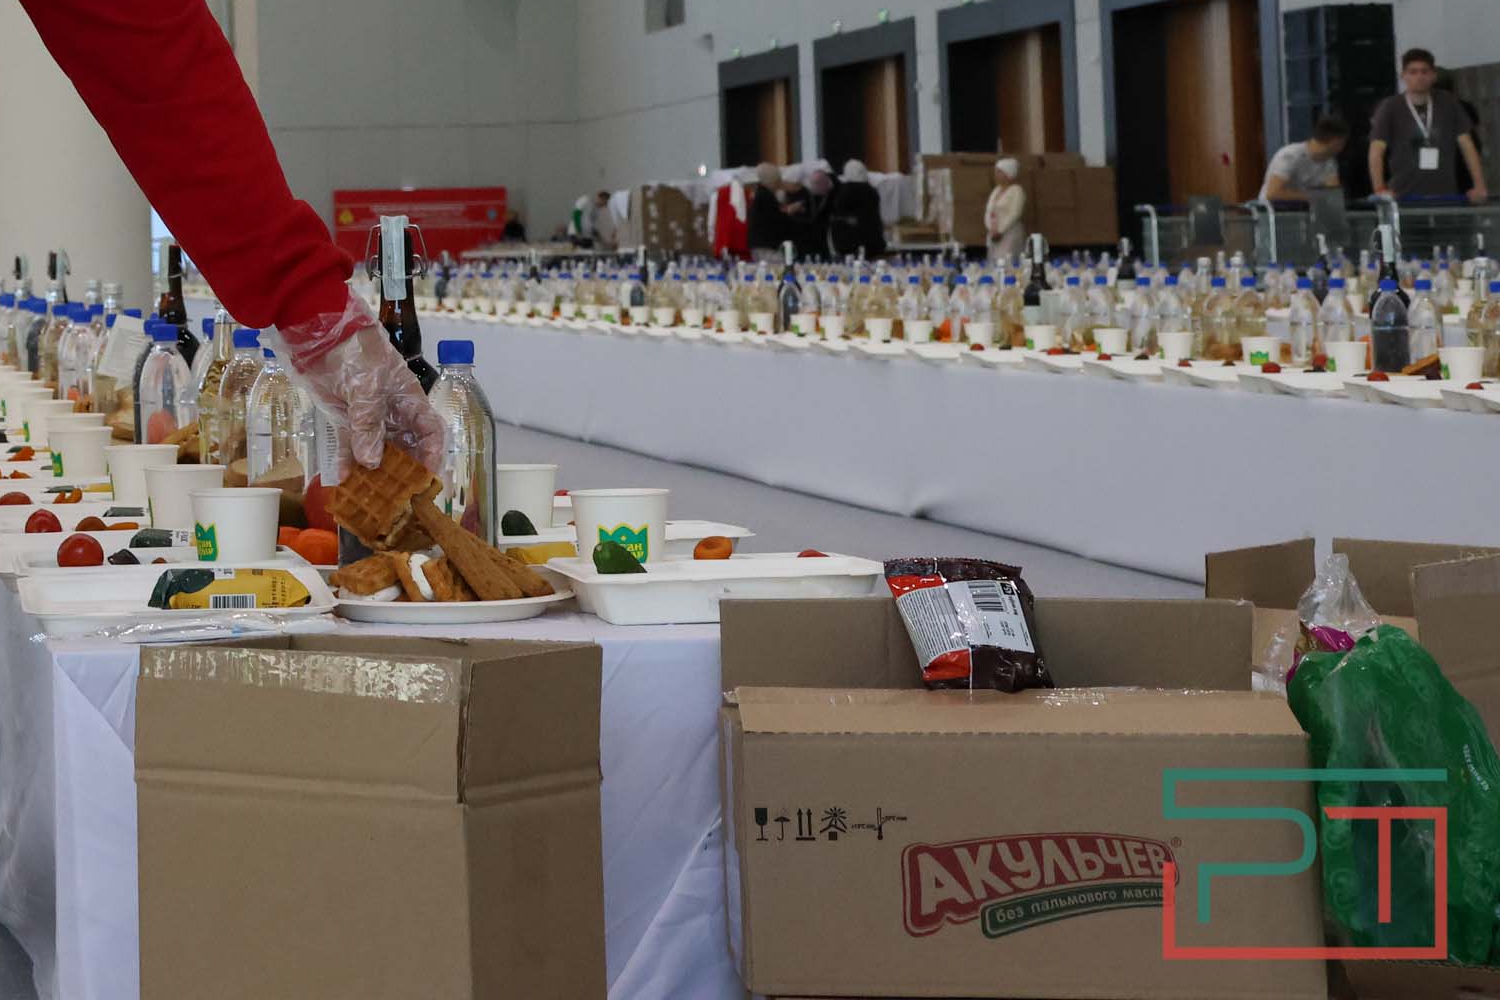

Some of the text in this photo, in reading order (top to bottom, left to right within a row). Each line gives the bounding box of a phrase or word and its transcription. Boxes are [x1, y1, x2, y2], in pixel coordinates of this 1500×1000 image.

[917, 837, 1165, 916] АКУЛЬЧЕВ
[996, 885, 1165, 923] без пальмового масл
